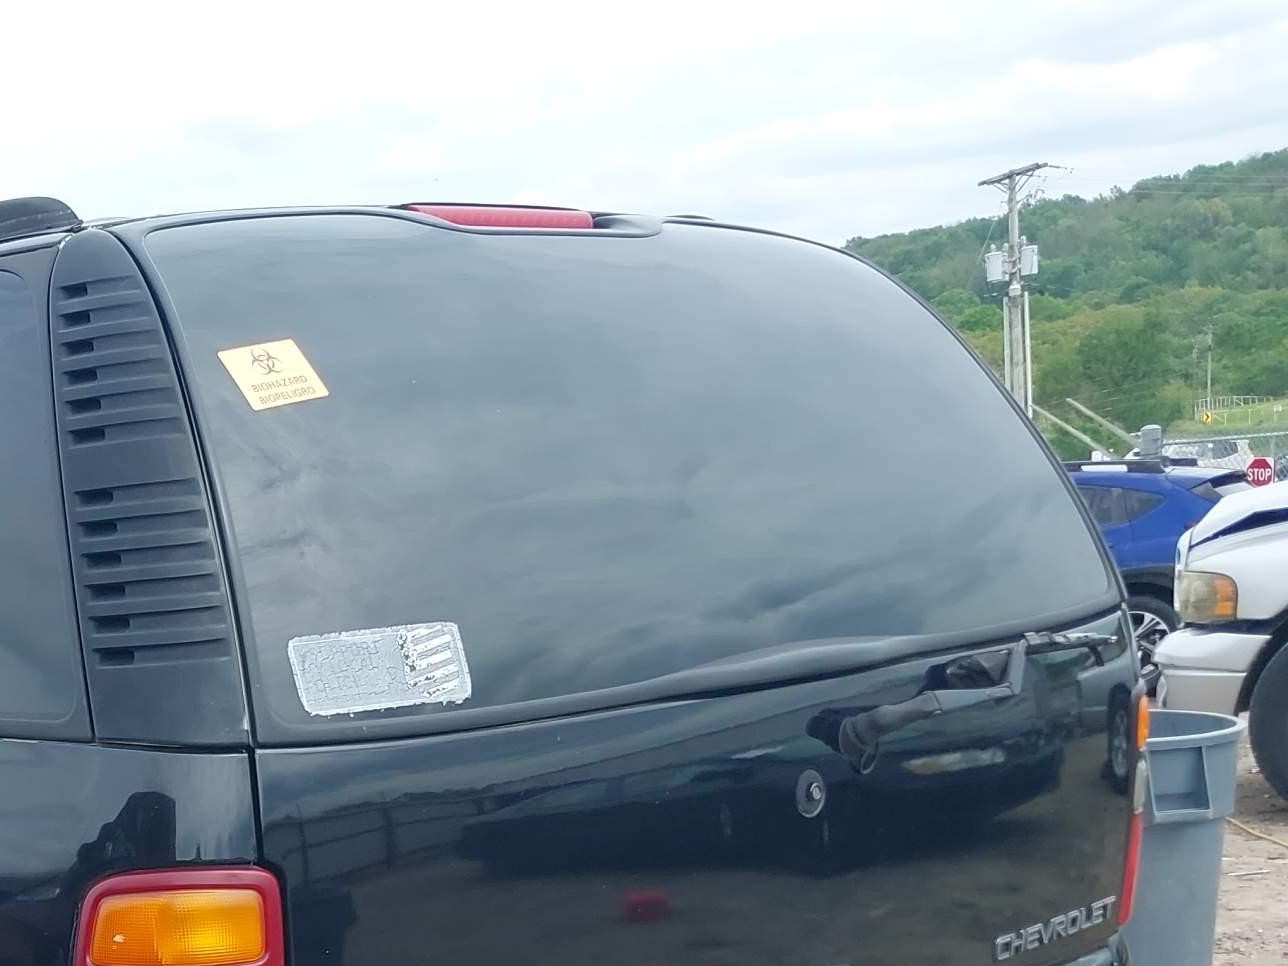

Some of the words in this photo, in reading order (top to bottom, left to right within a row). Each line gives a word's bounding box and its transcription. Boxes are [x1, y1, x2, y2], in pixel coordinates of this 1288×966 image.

[251, 375, 308, 393] BIOHAZARD
[258, 386, 316, 405] BIOPELIGRO
[1247, 468, 1271, 478] STOP
[996, 895, 1116, 961] CHEVROLET
